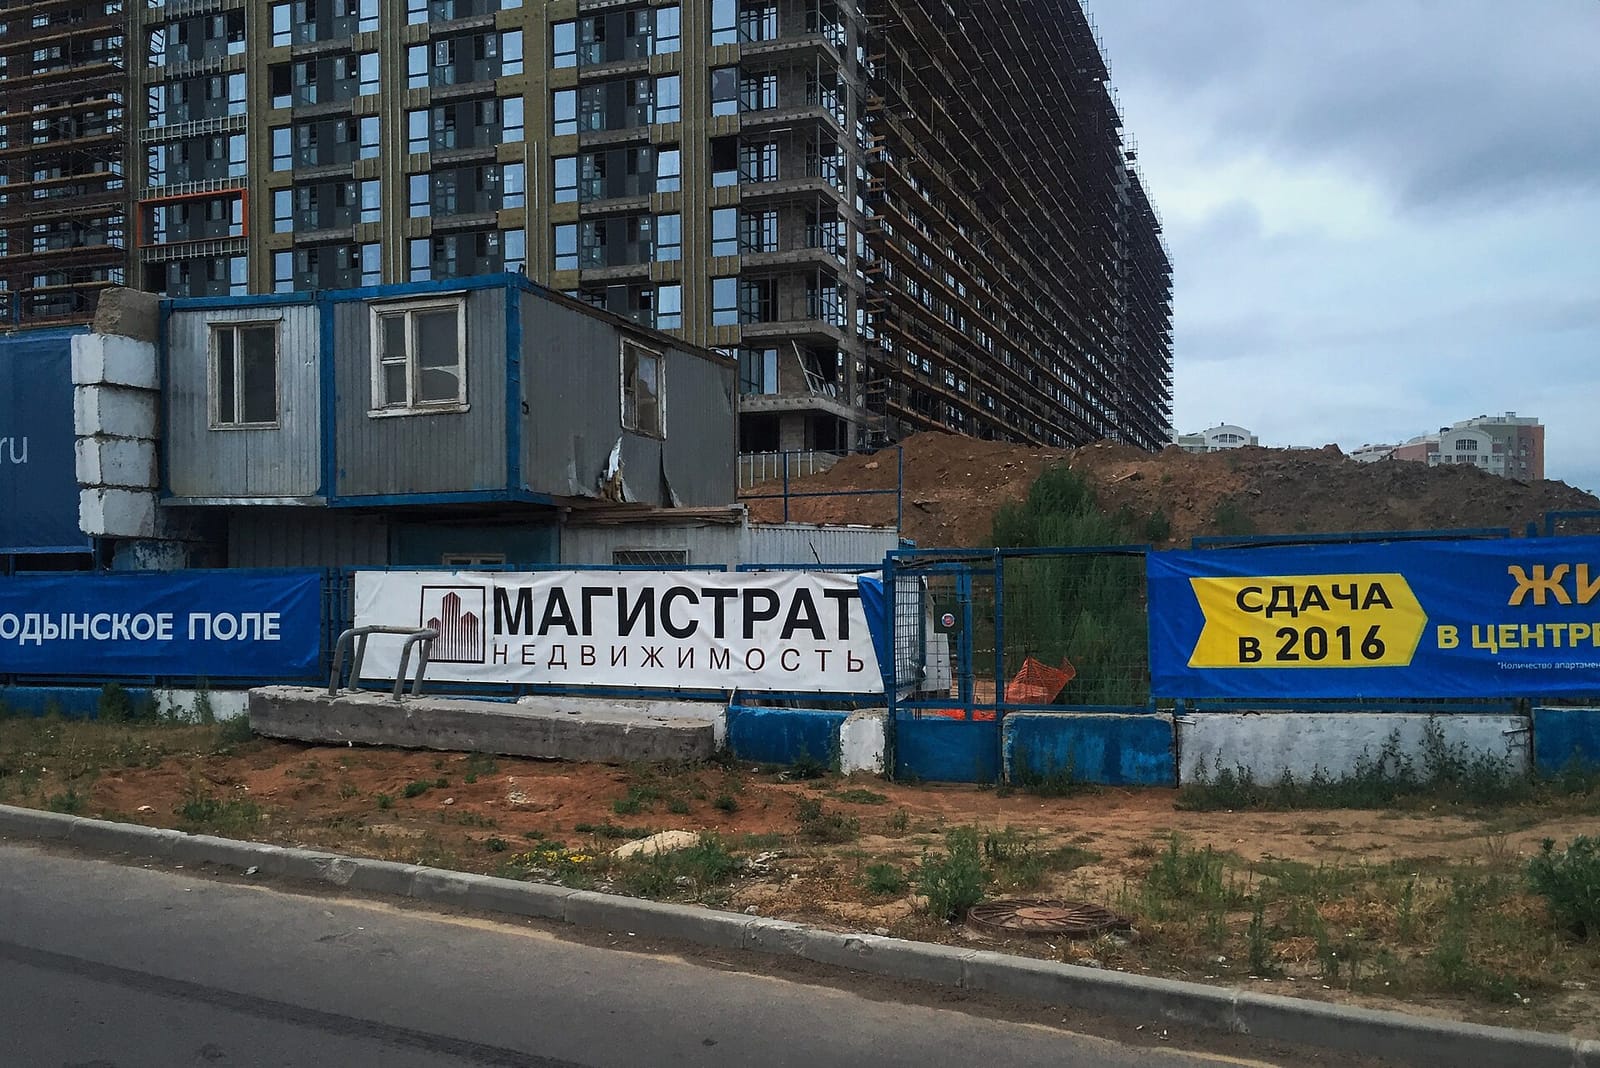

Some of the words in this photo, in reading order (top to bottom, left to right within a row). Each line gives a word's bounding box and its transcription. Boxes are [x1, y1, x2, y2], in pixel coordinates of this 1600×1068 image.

[0, 436, 28, 464] ru
[1236, 582, 1394, 619] СДАЧА
[1507, 563, 1600, 606] ЖИ
[0, 613, 174, 645] ОДЫНСКОЕ
[188, 612, 281, 641] ПОЛЕ
[493, 586, 862, 641] МАГИСТРАТ
[1275, 625, 1386, 661] 2016
[1437, 625, 1460, 649] В
[493, 644, 865, 673] НЕДВИЖИМОСТЬ
